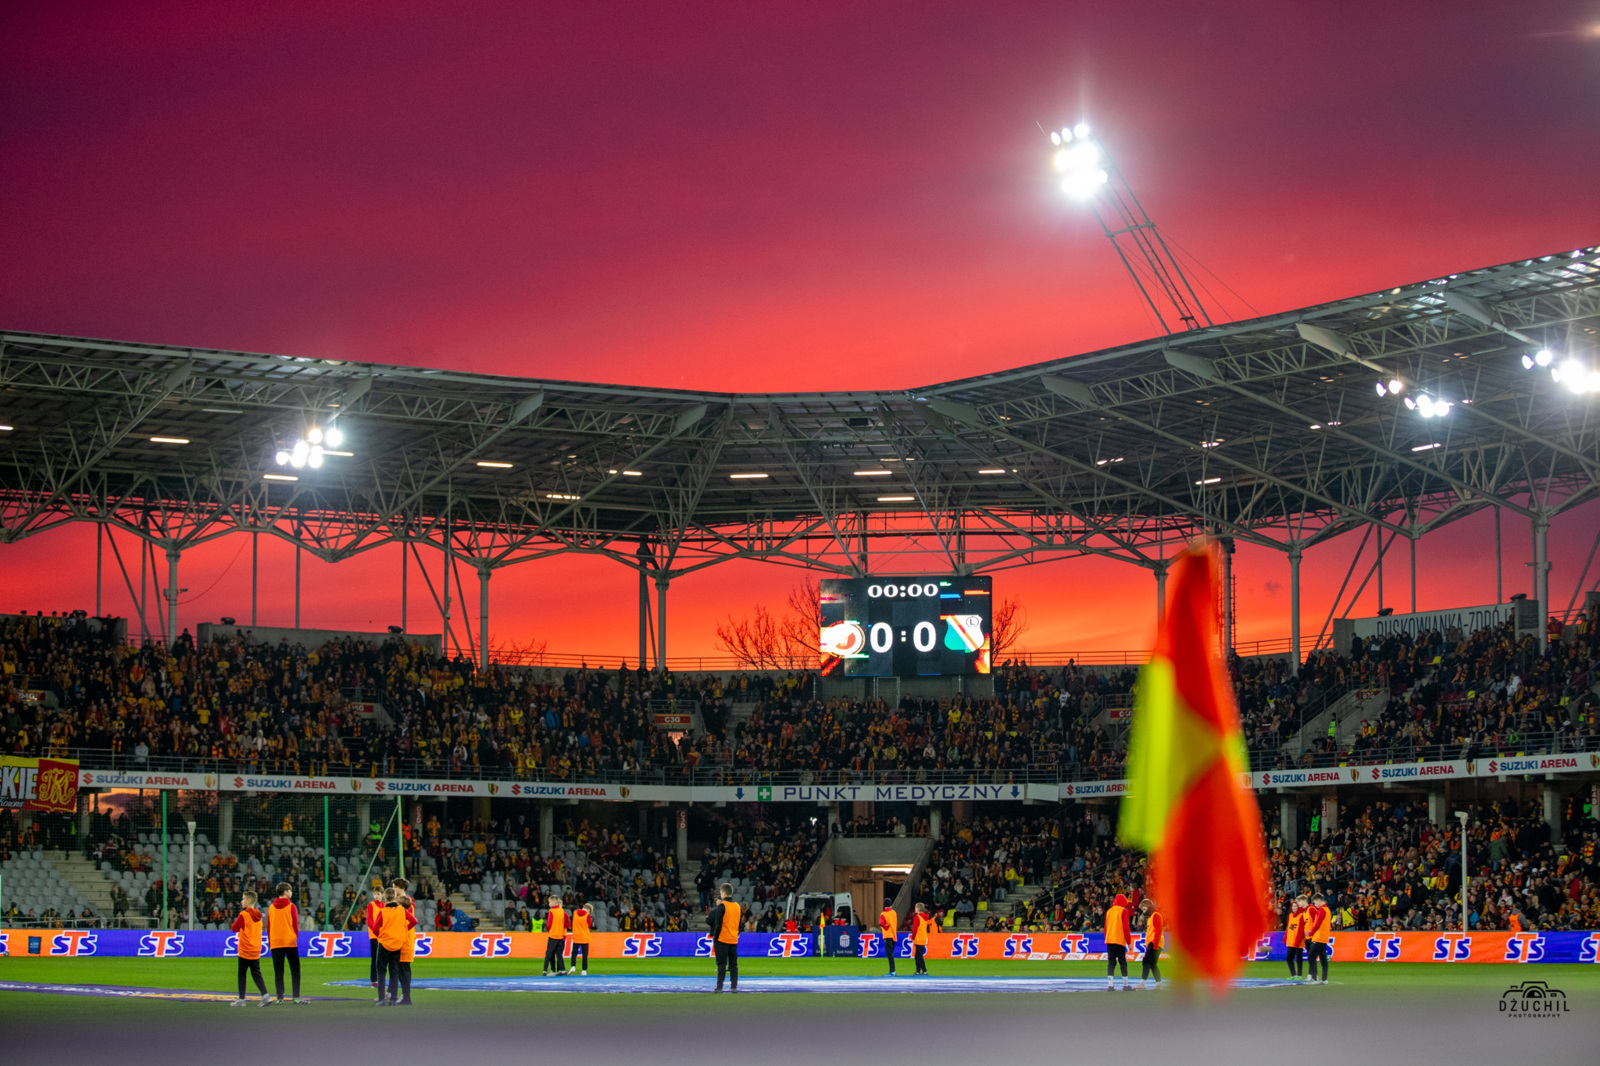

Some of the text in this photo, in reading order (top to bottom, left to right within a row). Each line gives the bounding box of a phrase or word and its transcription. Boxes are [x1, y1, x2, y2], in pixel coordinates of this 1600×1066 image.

[867, 584, 938, 598] 00:00
[1382, 765, 1454, 778] SUZUKI ARENA
[1500, 758, 1578, 771] SUZUKI ARENA
[0, 766, 39, 799] KIE
[96, 774, 189, 786] SUZUKI ARENA
[247, 779, 337, 790] SUZUKI ARENA
[388, 782, 475, 793] SUZUKI ARENA
[1075, 785, 1104, 794] SUZUKI
[1272, 772, 1340, 783] SUZUKI ARENA
[523, 786, 607, 796] SUZUKI ARENA
[784, 786, 1004, 800] PUNKT MEDYCZNY
[50, 930, 98, 957] STS
[138, 931, 185, 957] STS
[224, 932, 268, 957] SS
[308, 932, 352, 958] STS
[470, 932, 512, 958] STS
[622, 933, 662, 958] STS
[768, 933, 808, 958] STS
[901, 933, 928, 958] SS
[951, 933, 979, 958] STS
[1003, 934, 1033, 957] STS
[1059, 934, 1089, 954] STS
[1365, 932, 1401, 961] STS
[1433, 932, 1471, 962] STS
[1505, 932, 1545, 962] STS
